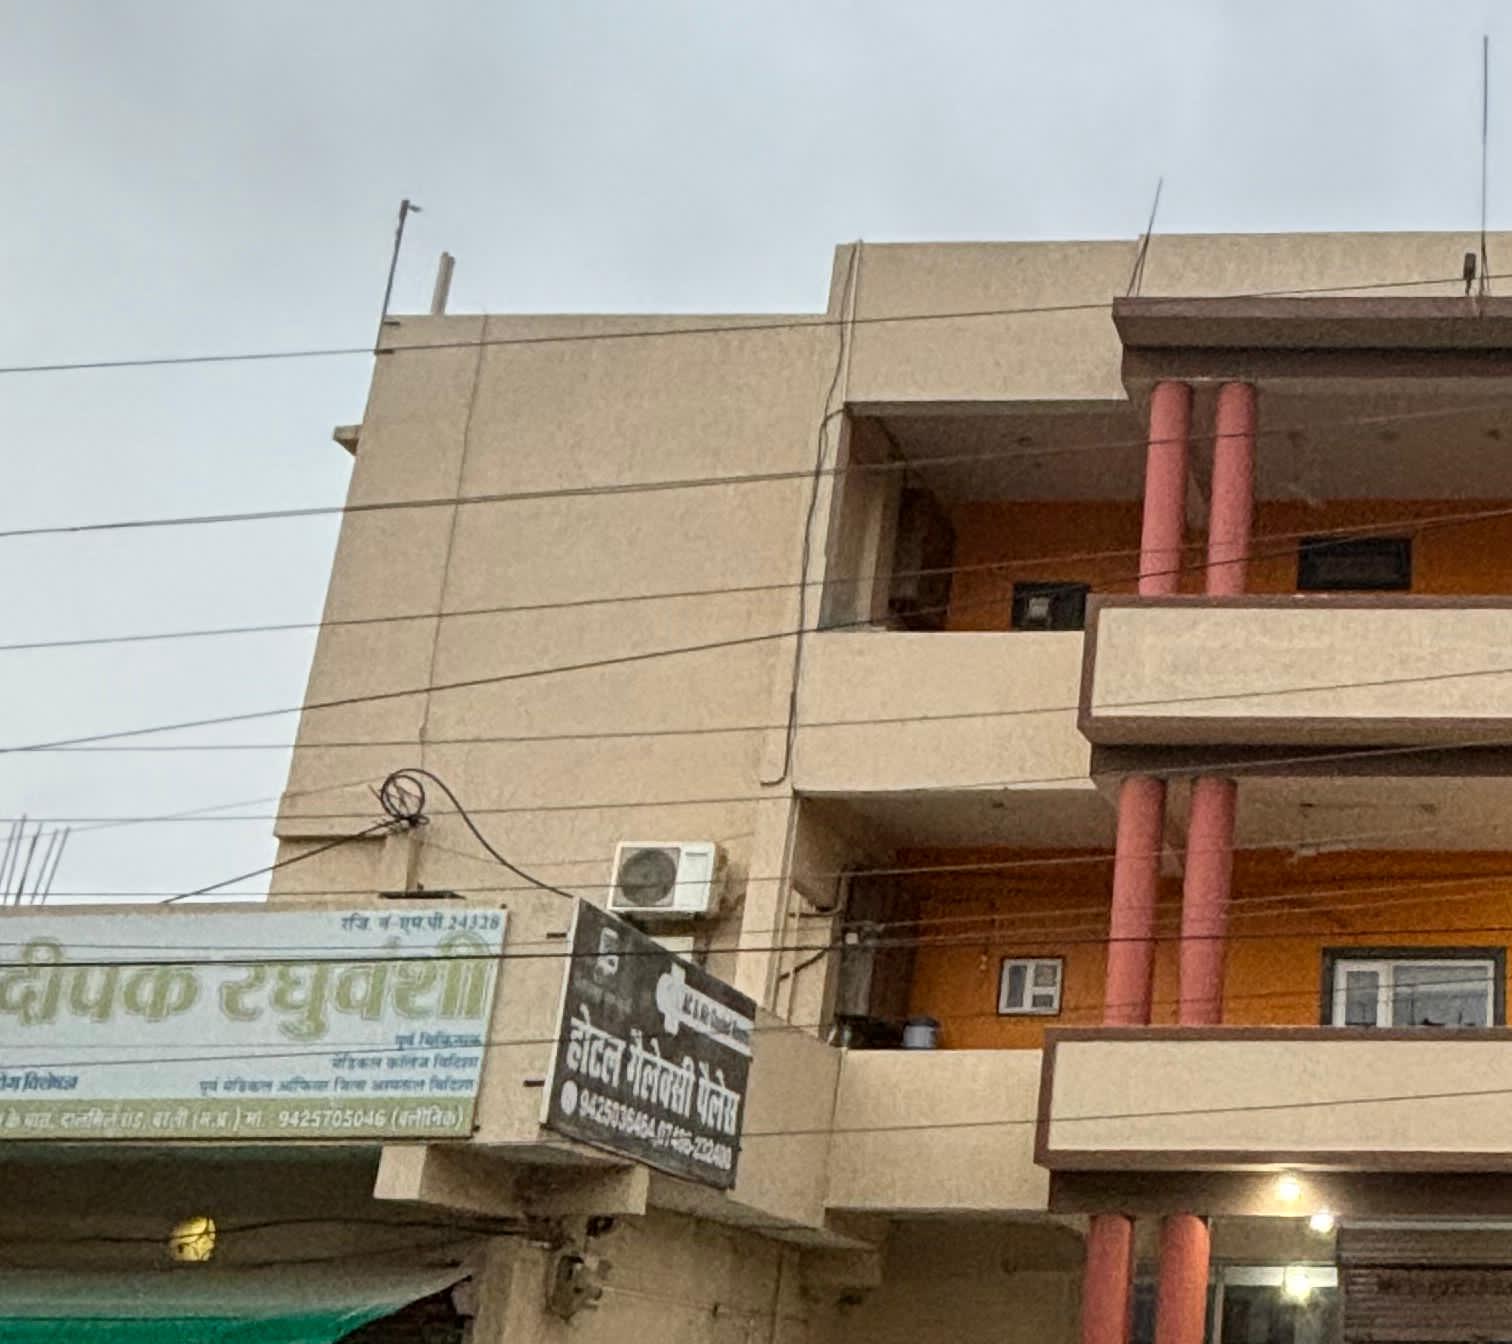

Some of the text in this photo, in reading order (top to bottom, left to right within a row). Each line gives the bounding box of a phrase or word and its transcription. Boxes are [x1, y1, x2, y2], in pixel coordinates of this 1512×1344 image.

[0, 931, 499, 1041] दीपक रघुवंशी
[566, 1003, 626, 1088] होटल
